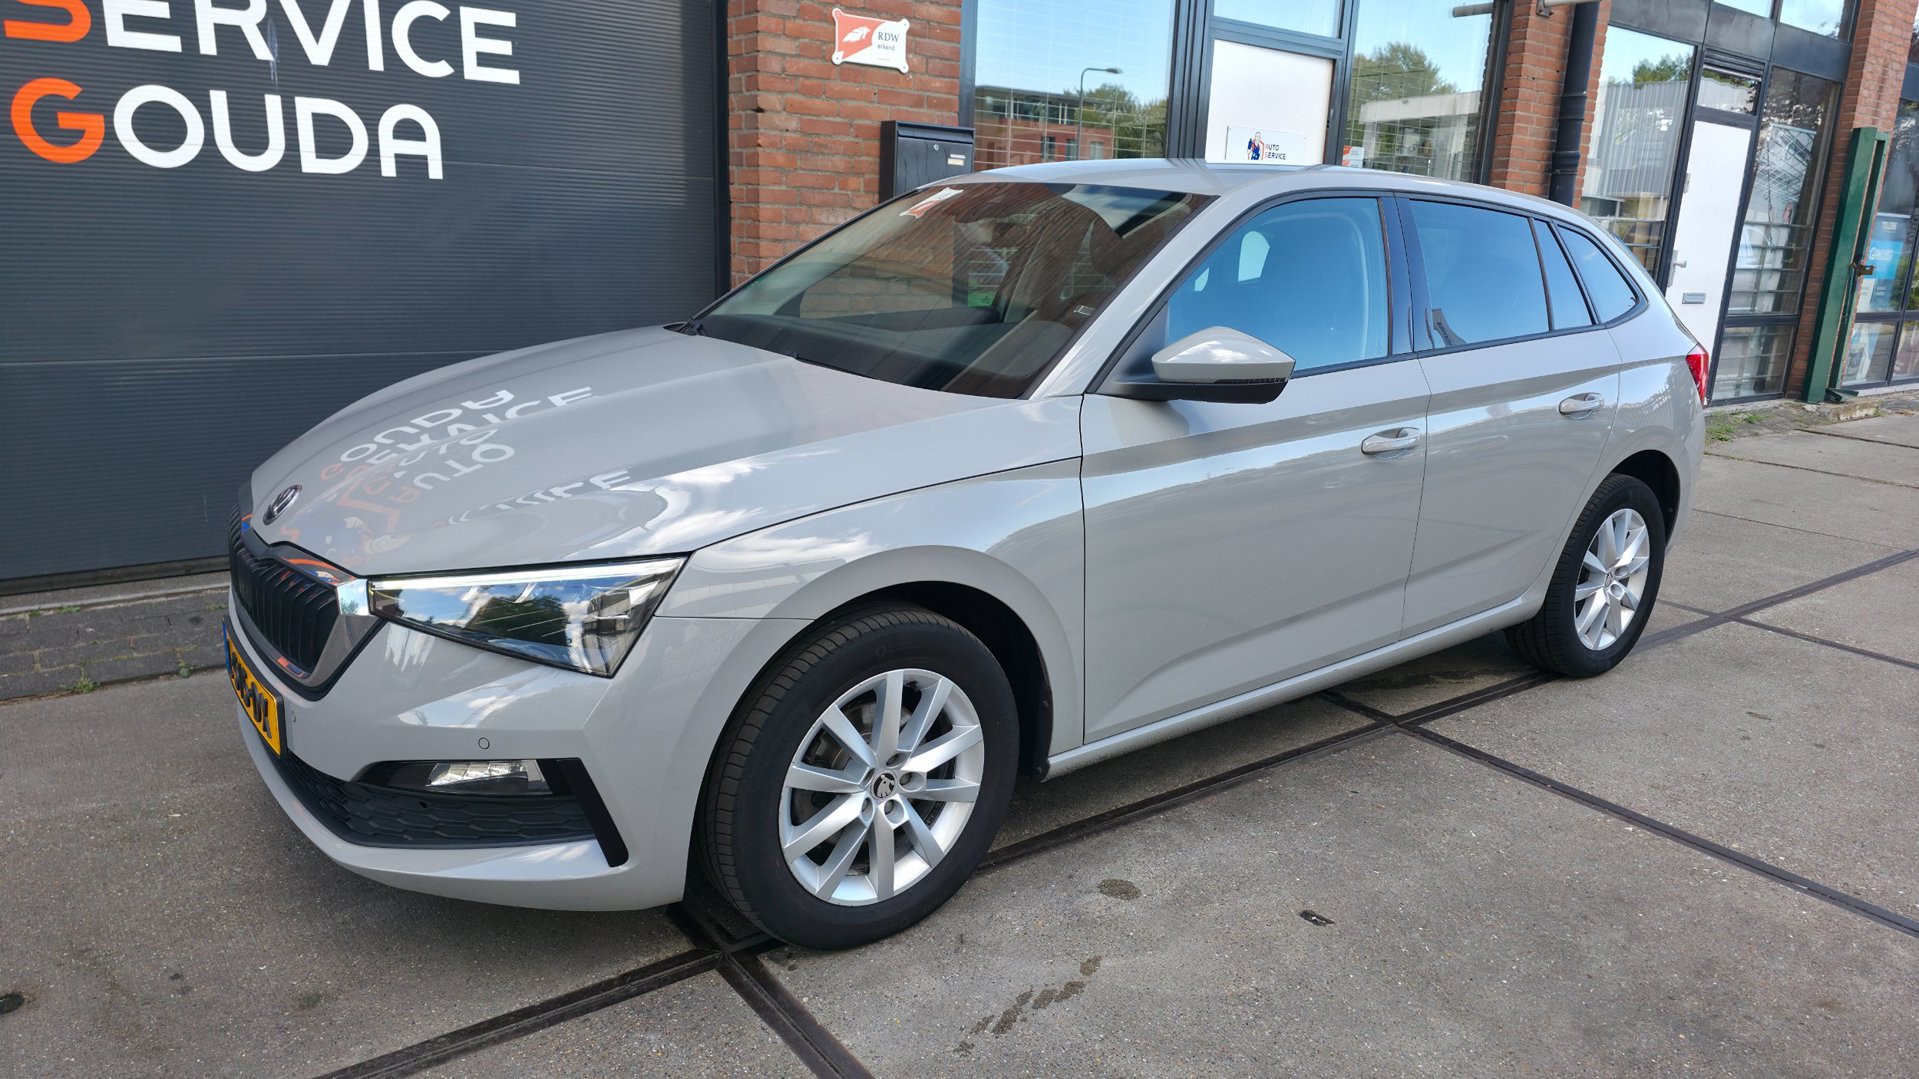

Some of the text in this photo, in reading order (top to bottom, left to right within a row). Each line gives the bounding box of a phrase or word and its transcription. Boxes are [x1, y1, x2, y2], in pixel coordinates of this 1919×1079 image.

[878, 31, 899, 42] RDW
[11, 77, 443, 180] GOUDA
[1265, 152, 1286, 160] SERVICE
